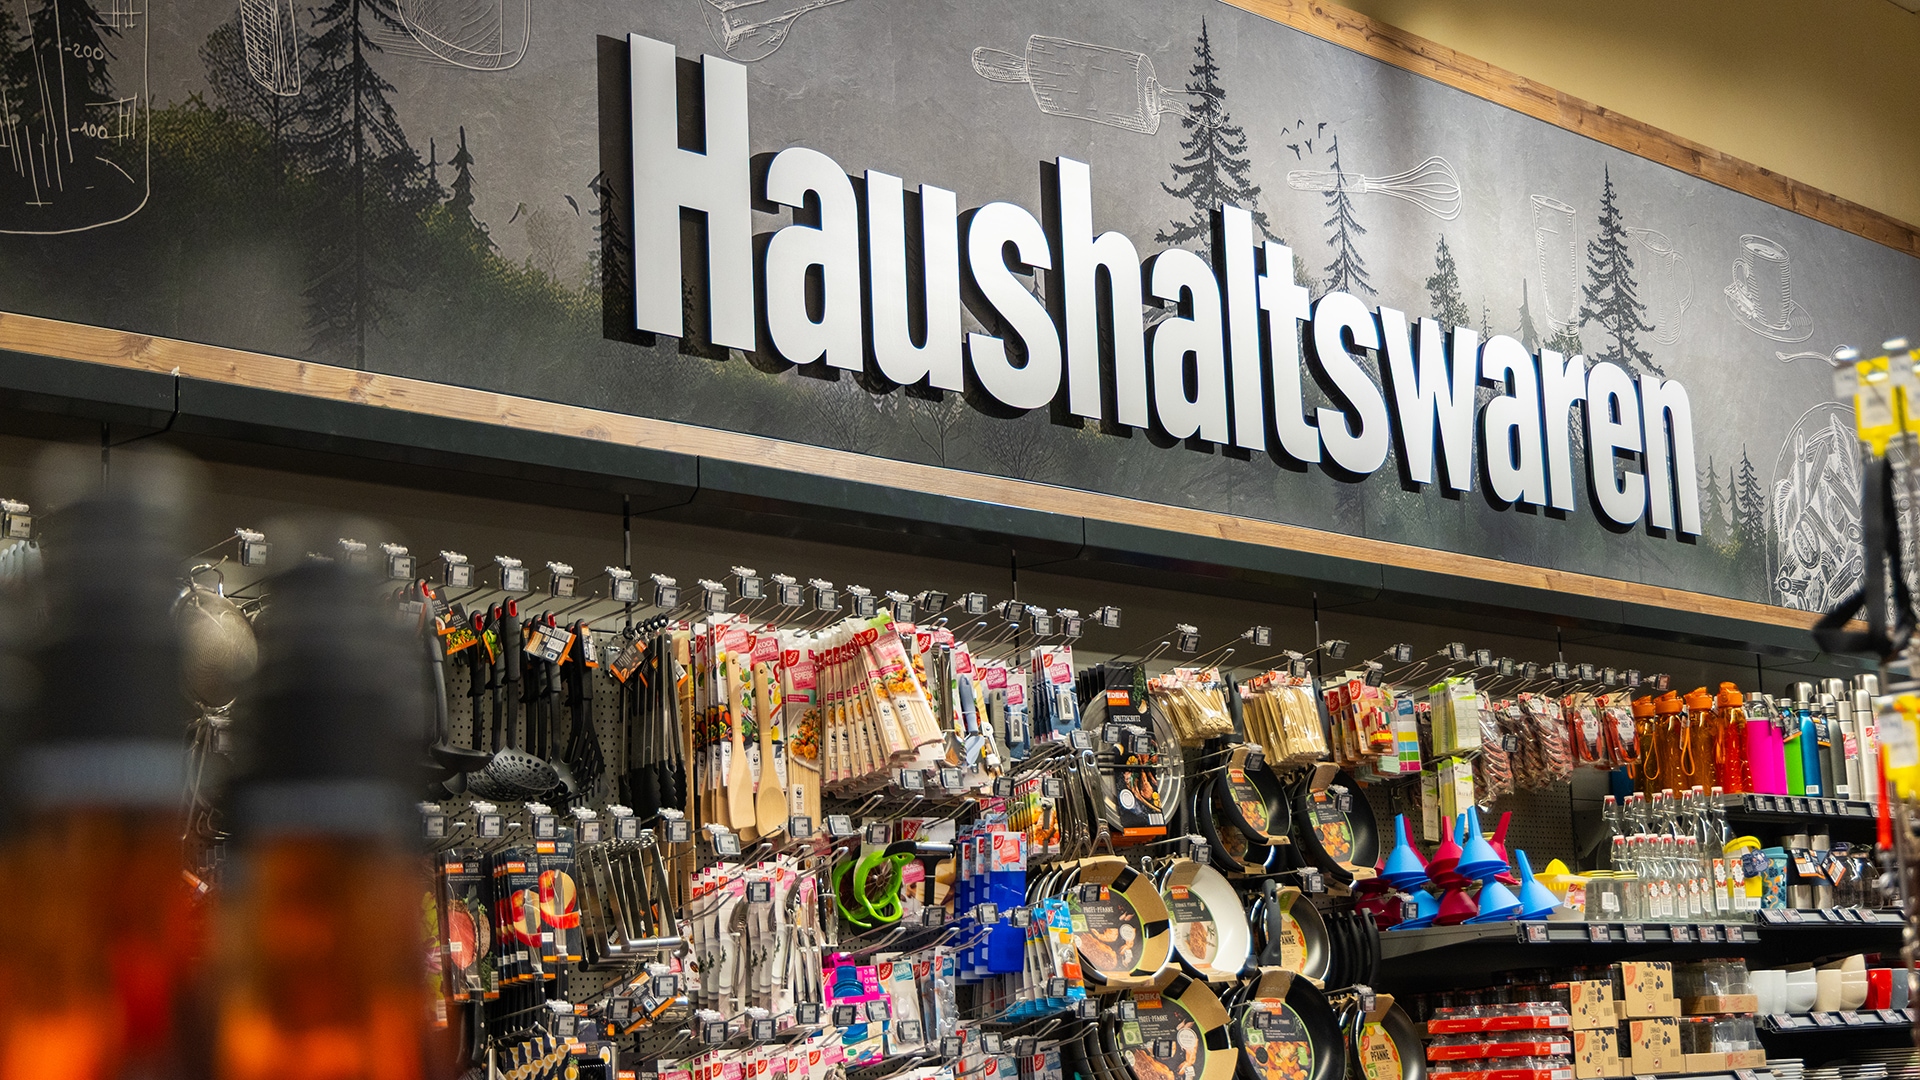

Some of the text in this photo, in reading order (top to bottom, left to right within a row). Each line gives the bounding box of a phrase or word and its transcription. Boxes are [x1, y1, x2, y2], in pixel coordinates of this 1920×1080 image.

[627, 33, 1702, 537] Haushaltswaren
[757, 639, 775, 649] KOCH
[1134, 993, 1161, 1001] EDEKA
[1370, 1050, 1391, 1062] PFANNE
